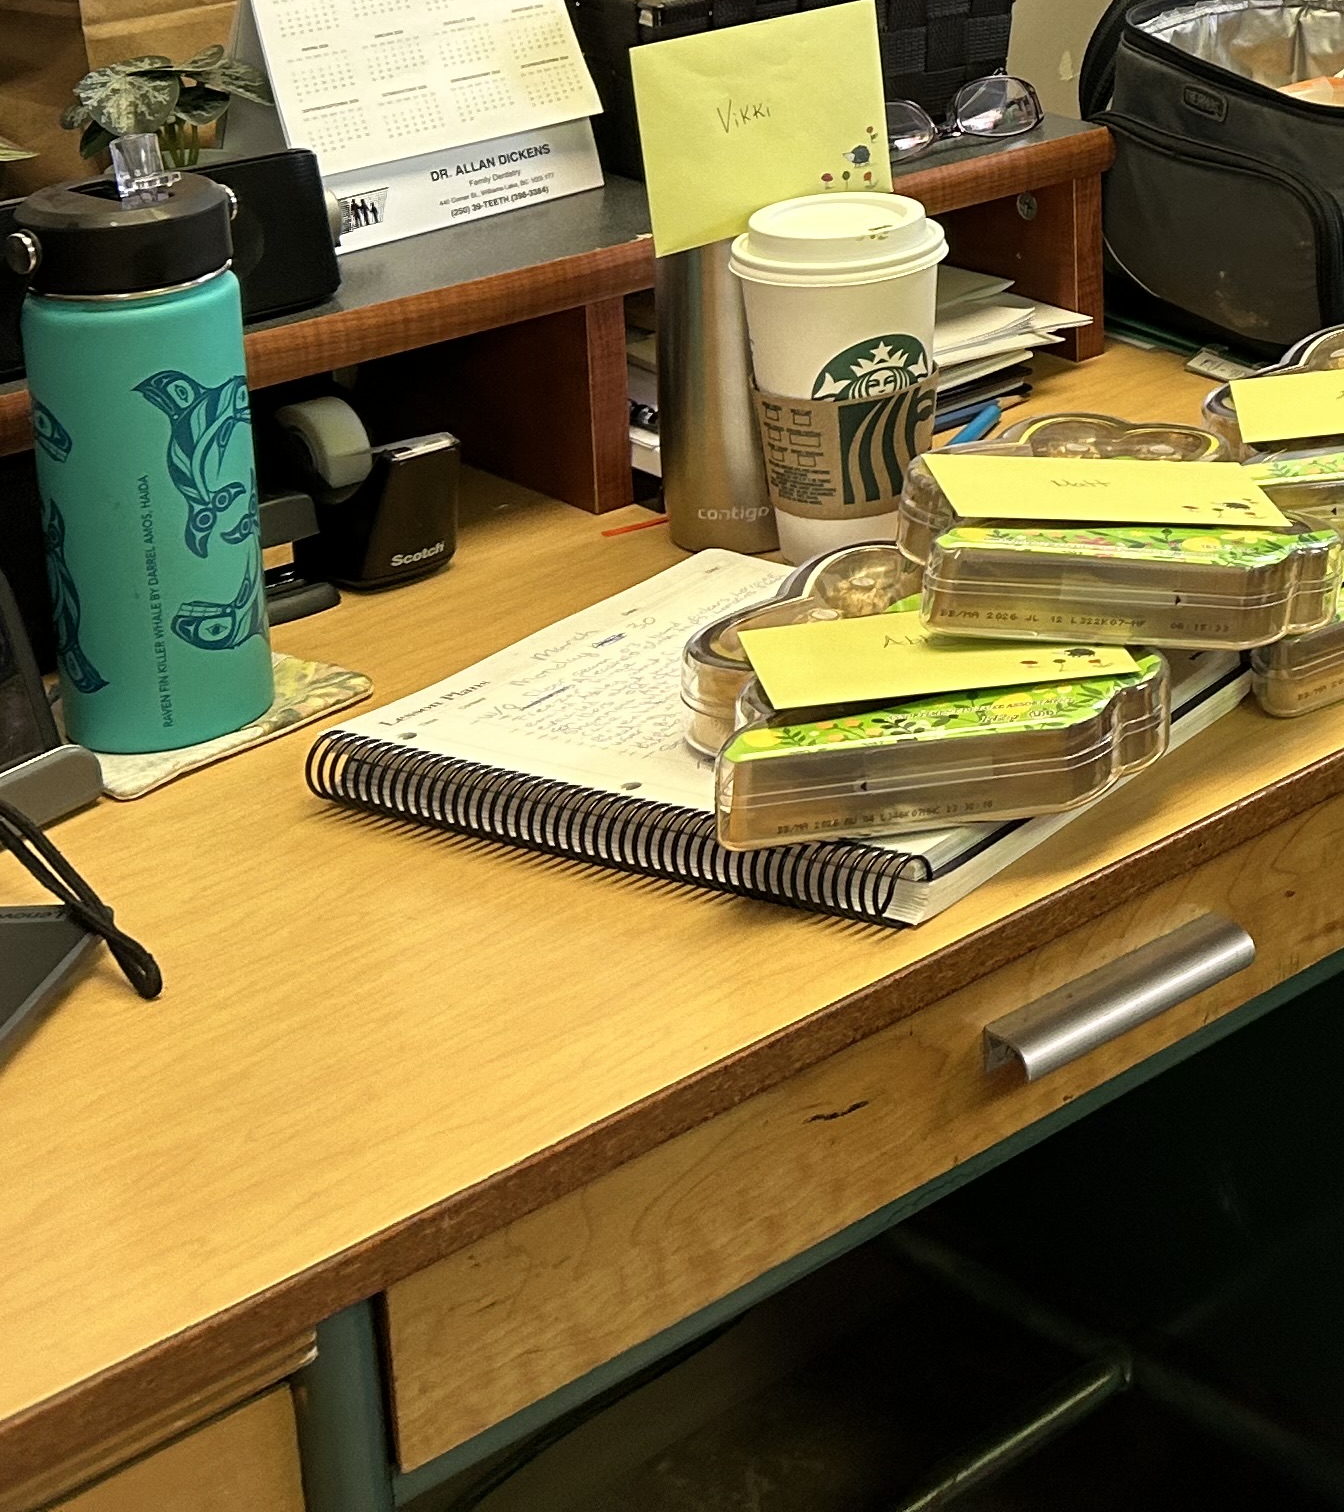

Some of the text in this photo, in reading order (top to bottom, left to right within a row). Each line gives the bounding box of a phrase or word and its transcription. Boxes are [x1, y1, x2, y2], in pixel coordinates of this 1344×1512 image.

[430, 144, 551, 182] DR. ALLAN DICKENS
[469, 169, 521, 186] Family Dentistry
[697, 506, 770, 522] contigo
[390, 541, 446, 568] Scotch
[138, 475, 173, 728] RAVEN FIN KILLER WHALE BY DARREL AMOS, HAIDA
[986, 611, 1018, 621] 2026
[379, 680, 491, 727] Lesson Plans
